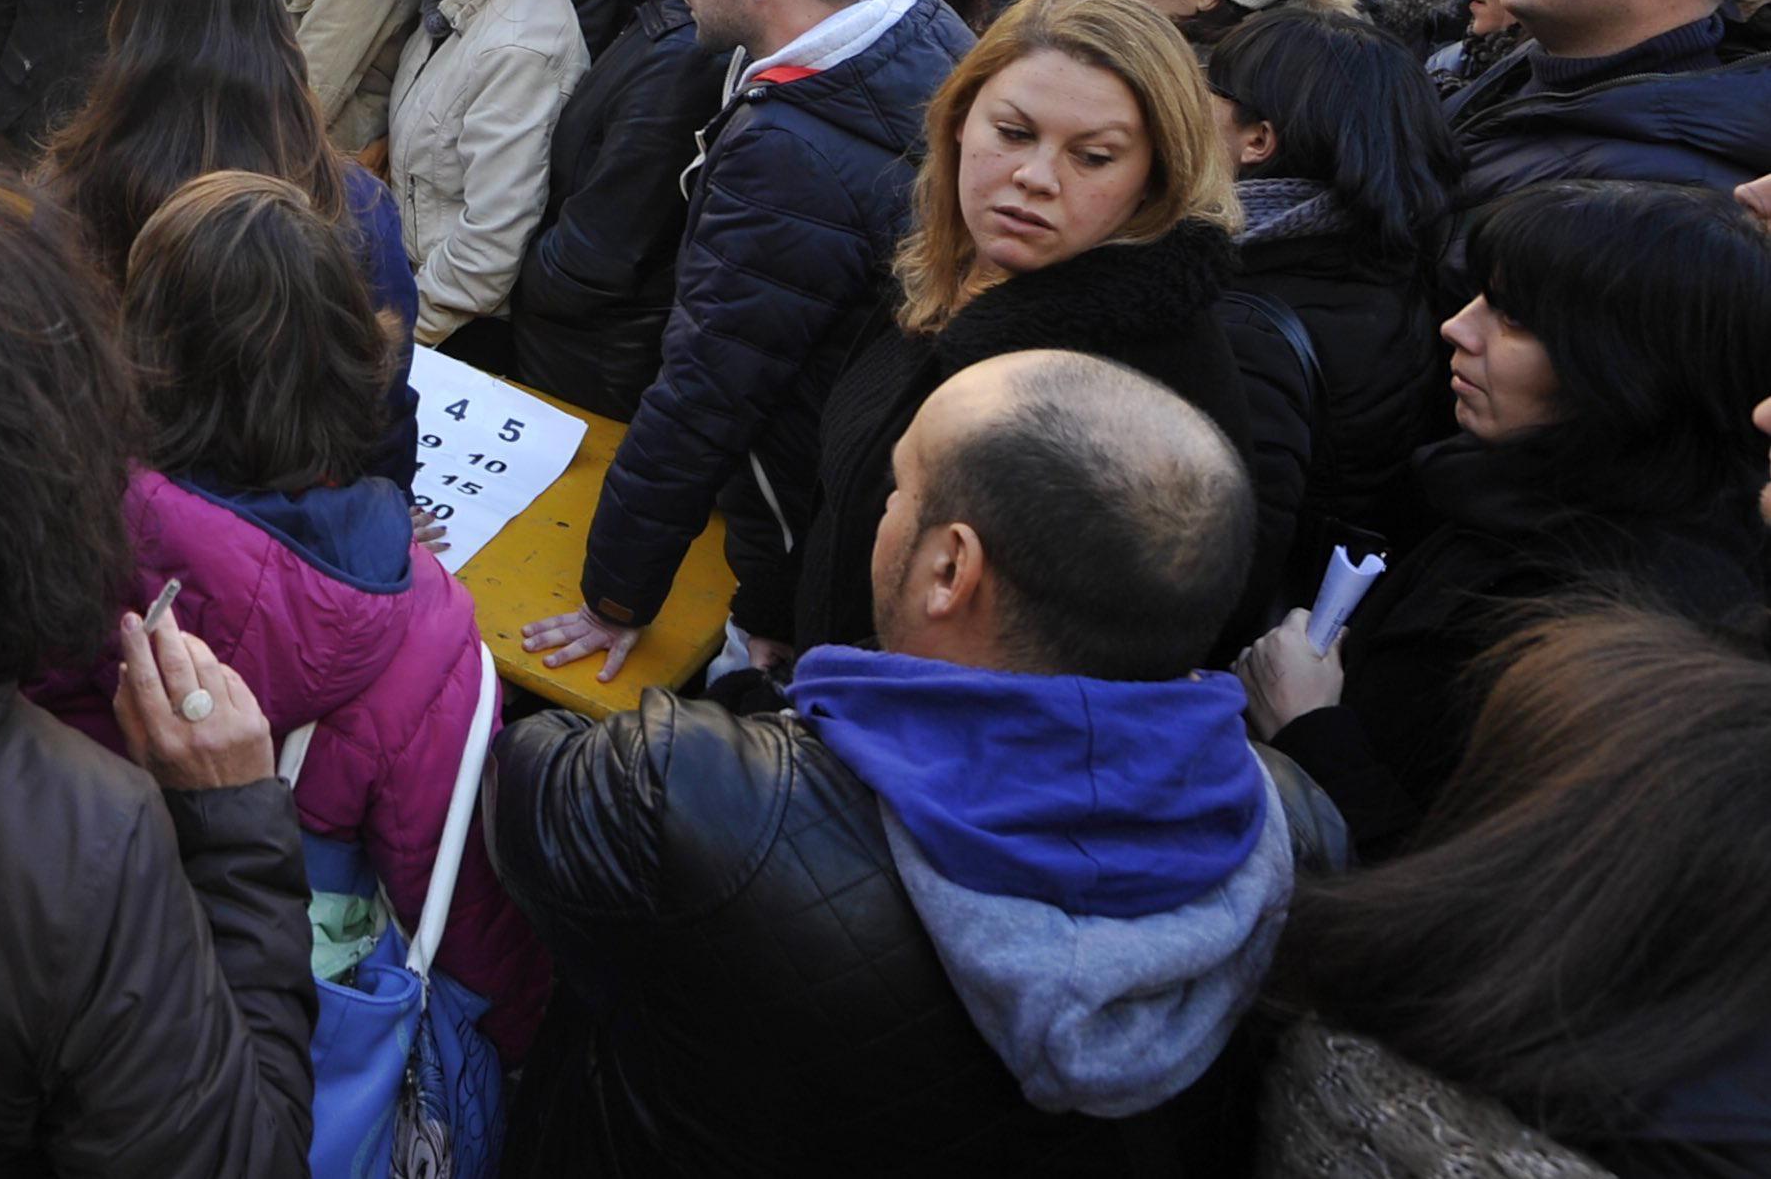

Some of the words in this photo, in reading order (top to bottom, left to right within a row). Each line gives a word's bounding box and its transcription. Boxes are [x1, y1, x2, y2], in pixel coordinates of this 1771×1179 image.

[444, 398, 470, 422] 4
[498, 418, 526, 443] 5
[419, 434, 443, 449] 9
[467, 453, 508, 474] 10
[441, 474, 484, 496] 15
[415, 495, 455, 521] 20
